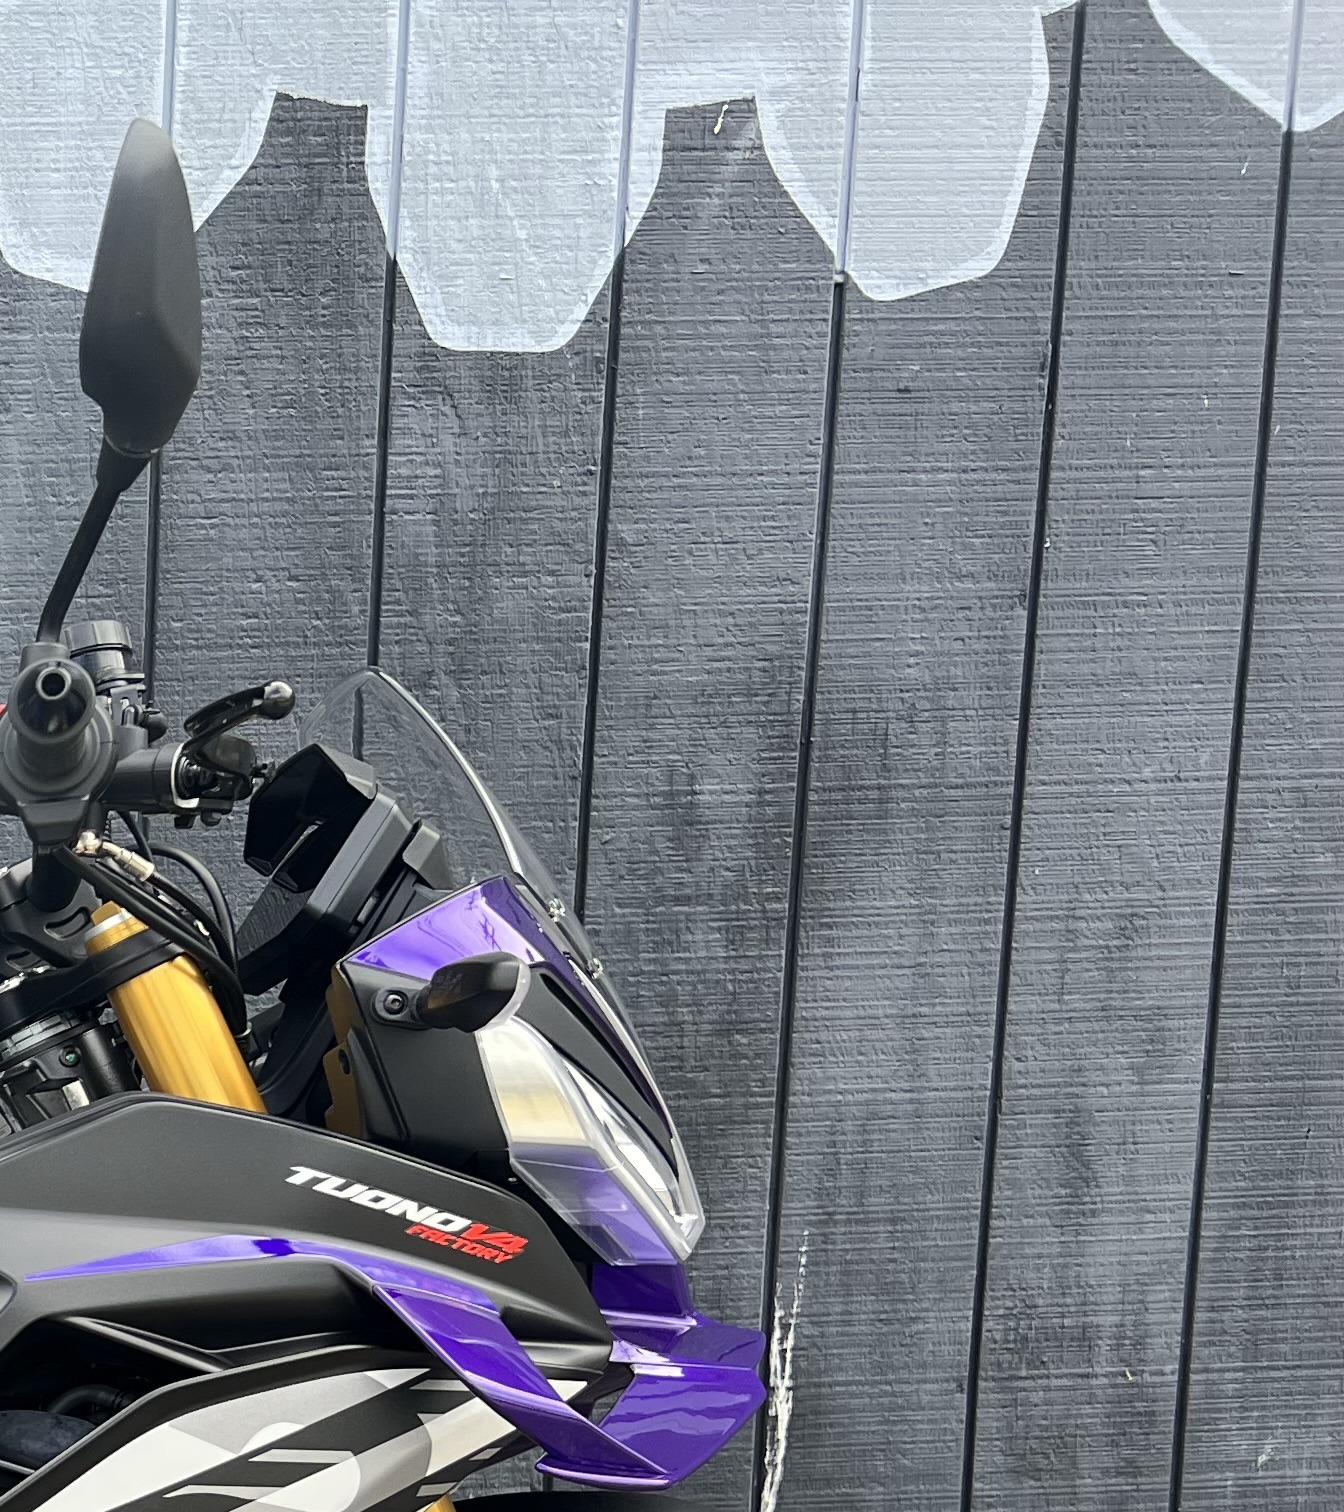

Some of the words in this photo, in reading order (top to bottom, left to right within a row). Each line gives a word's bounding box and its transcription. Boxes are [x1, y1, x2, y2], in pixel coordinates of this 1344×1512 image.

[285, 1166, 472, 1232] TUONO
[460, 1222, 528, 1254] V4
[406, 1225, 513, 1264] FACTORY
